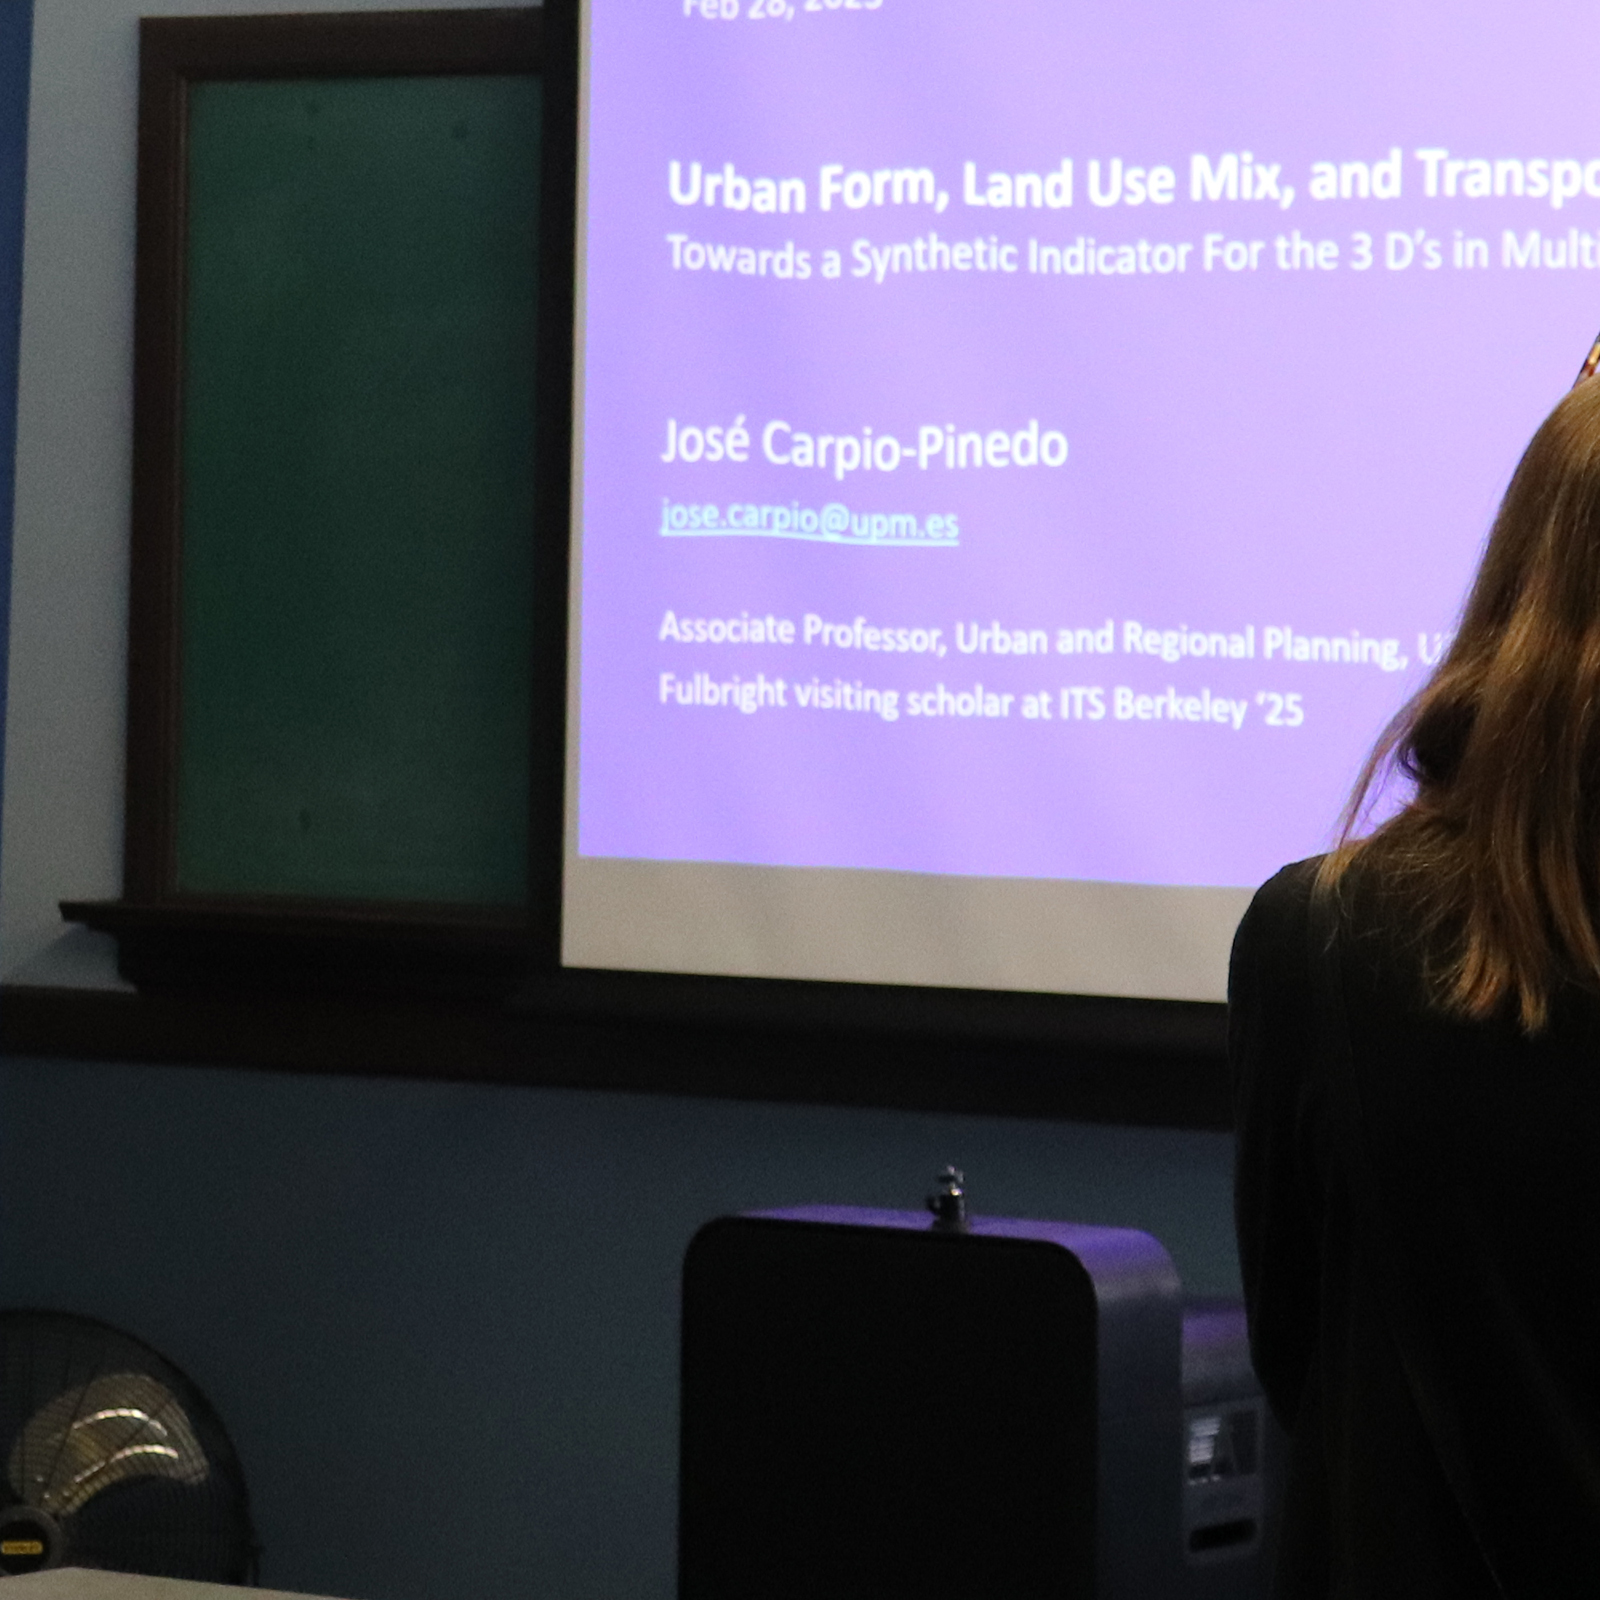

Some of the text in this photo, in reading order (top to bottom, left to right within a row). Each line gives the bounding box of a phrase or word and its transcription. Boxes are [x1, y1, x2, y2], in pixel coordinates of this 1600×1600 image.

[667, 158, 806, 214] Urban
[818, 161, 950, 213] Form,
[962, 157, 1072, 208] Land
[1086, 157, 1176, 206] Use
[1189, 151, 1295, 209] Mix,
[1309, 147, 1402, 200] and
[666, 232, 811, 280] Towards
[821, 248, 842, 280] a
[851, 231, 1017, 284] Synthetic
[1028, 234, 1193, 275] Indicator
[1203, 232, 1266, 271] For
[1275, 229, 1340, 271] the
[1350, 231, 1373, 271] 3
[1385, 228, 1443, 271] D's
[1452, 229, 1490, 269] in
[660, 413, 1068, 480] José Carpio-Pinedo
[658, 498, 960, 542] jose.carpio@upm.es
[658, 609, 796, 645] Associate
[803, 612, 947, 658] Professor,
[955, 619, 1049, 656] Urban
[1055, 619, 1114, 656] and
[1122, 620, 1256, 665] Regional
[1263, 626, 1408, 672] Planning,
[658, 672, 1305, 730] Fulbright visiting scholar at ITS Berkeley '25
